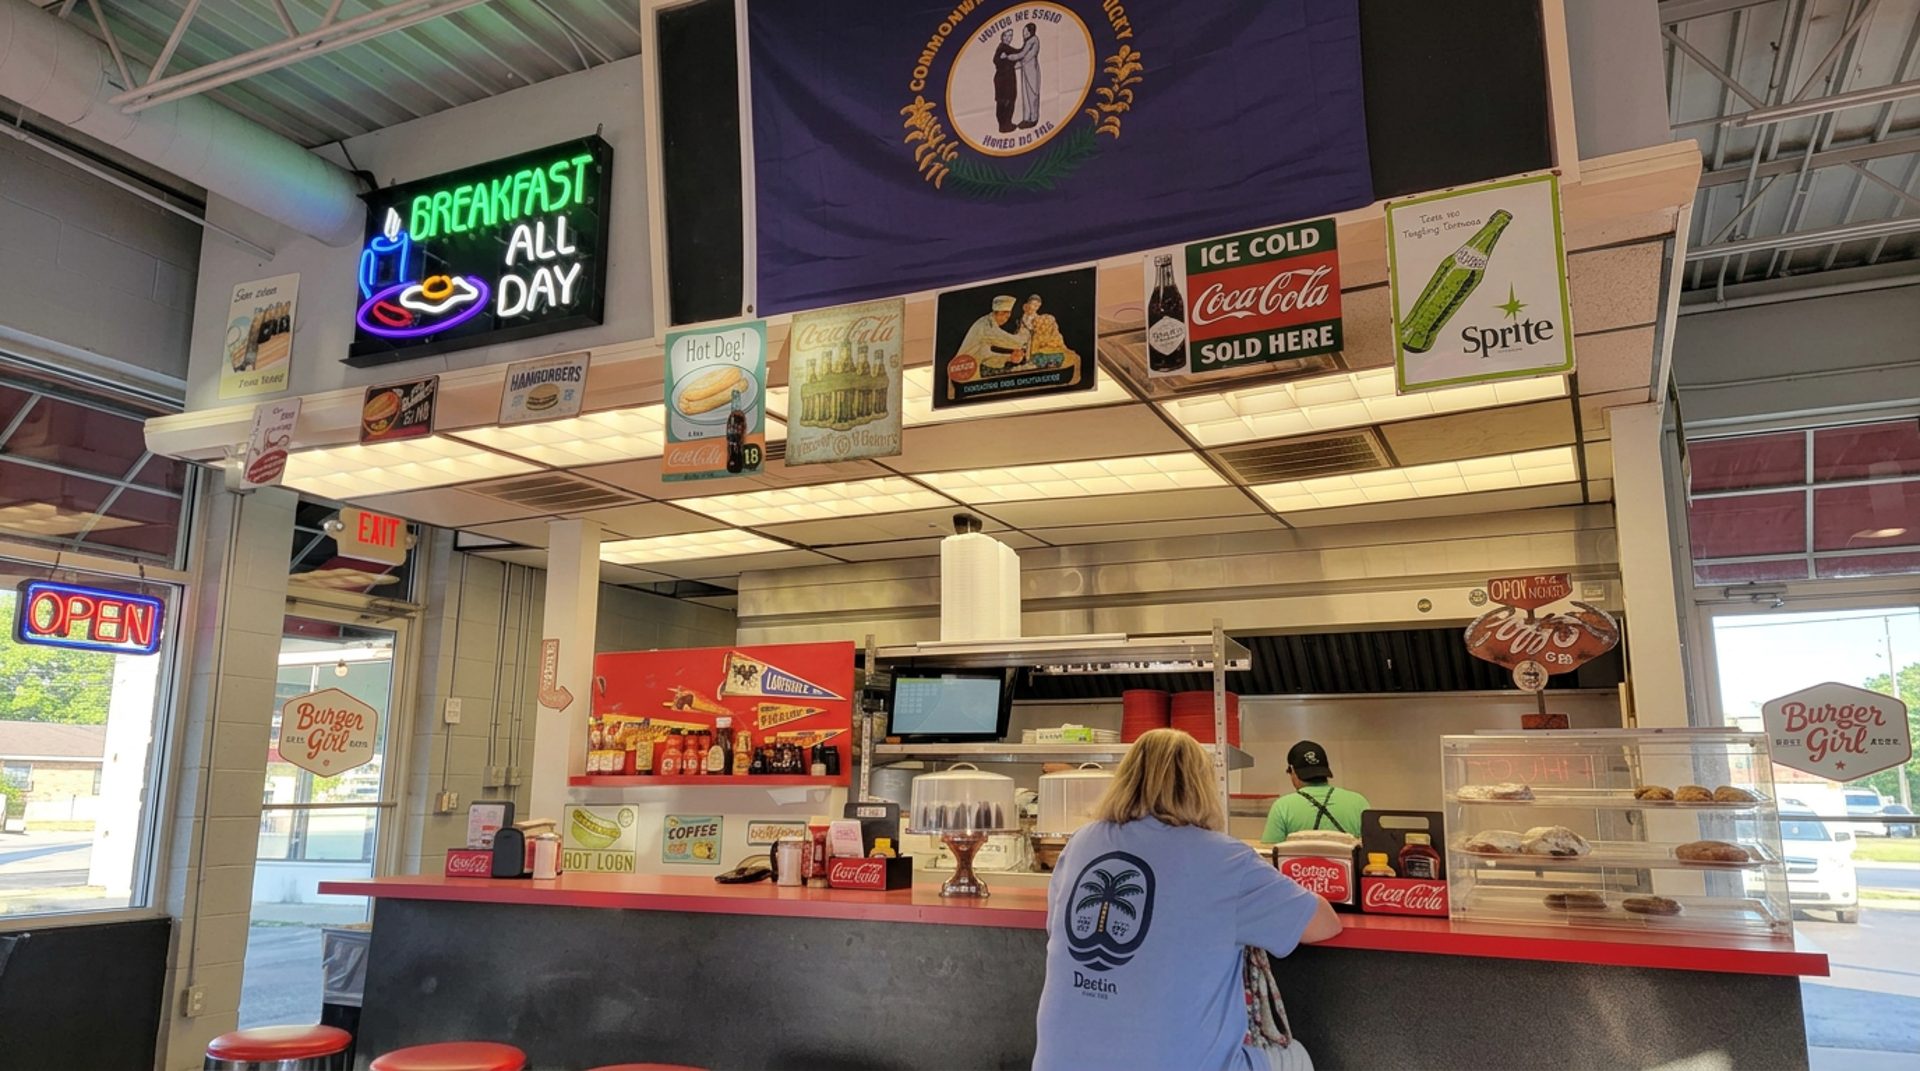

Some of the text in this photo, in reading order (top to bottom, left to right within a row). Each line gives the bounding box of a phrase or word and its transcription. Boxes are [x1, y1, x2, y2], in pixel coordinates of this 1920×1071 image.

[410, 154, 593, 241] BREAKFAST
[506, 216, 576, 266] ALL
[1200, 227, 1320, 267] ICE COLD
[497, 263, 581, 317] DAY
[686, 339, 711, 363] Hot
[1201, 325, 1335, 365] SOLD HERE
[1461, 317, 1554, 358] Sprite
[744, 448, 759, 465] 18
[358, 511, 401, 548] EXIT
[29, 592, 155, 646] OPEN
[297, 703, 364, 732] Burger
[1781, 702, 1886, 732] Burger
[307, 728, 350, 760] Girl
[1806, 725, 1868, 762] Girl
